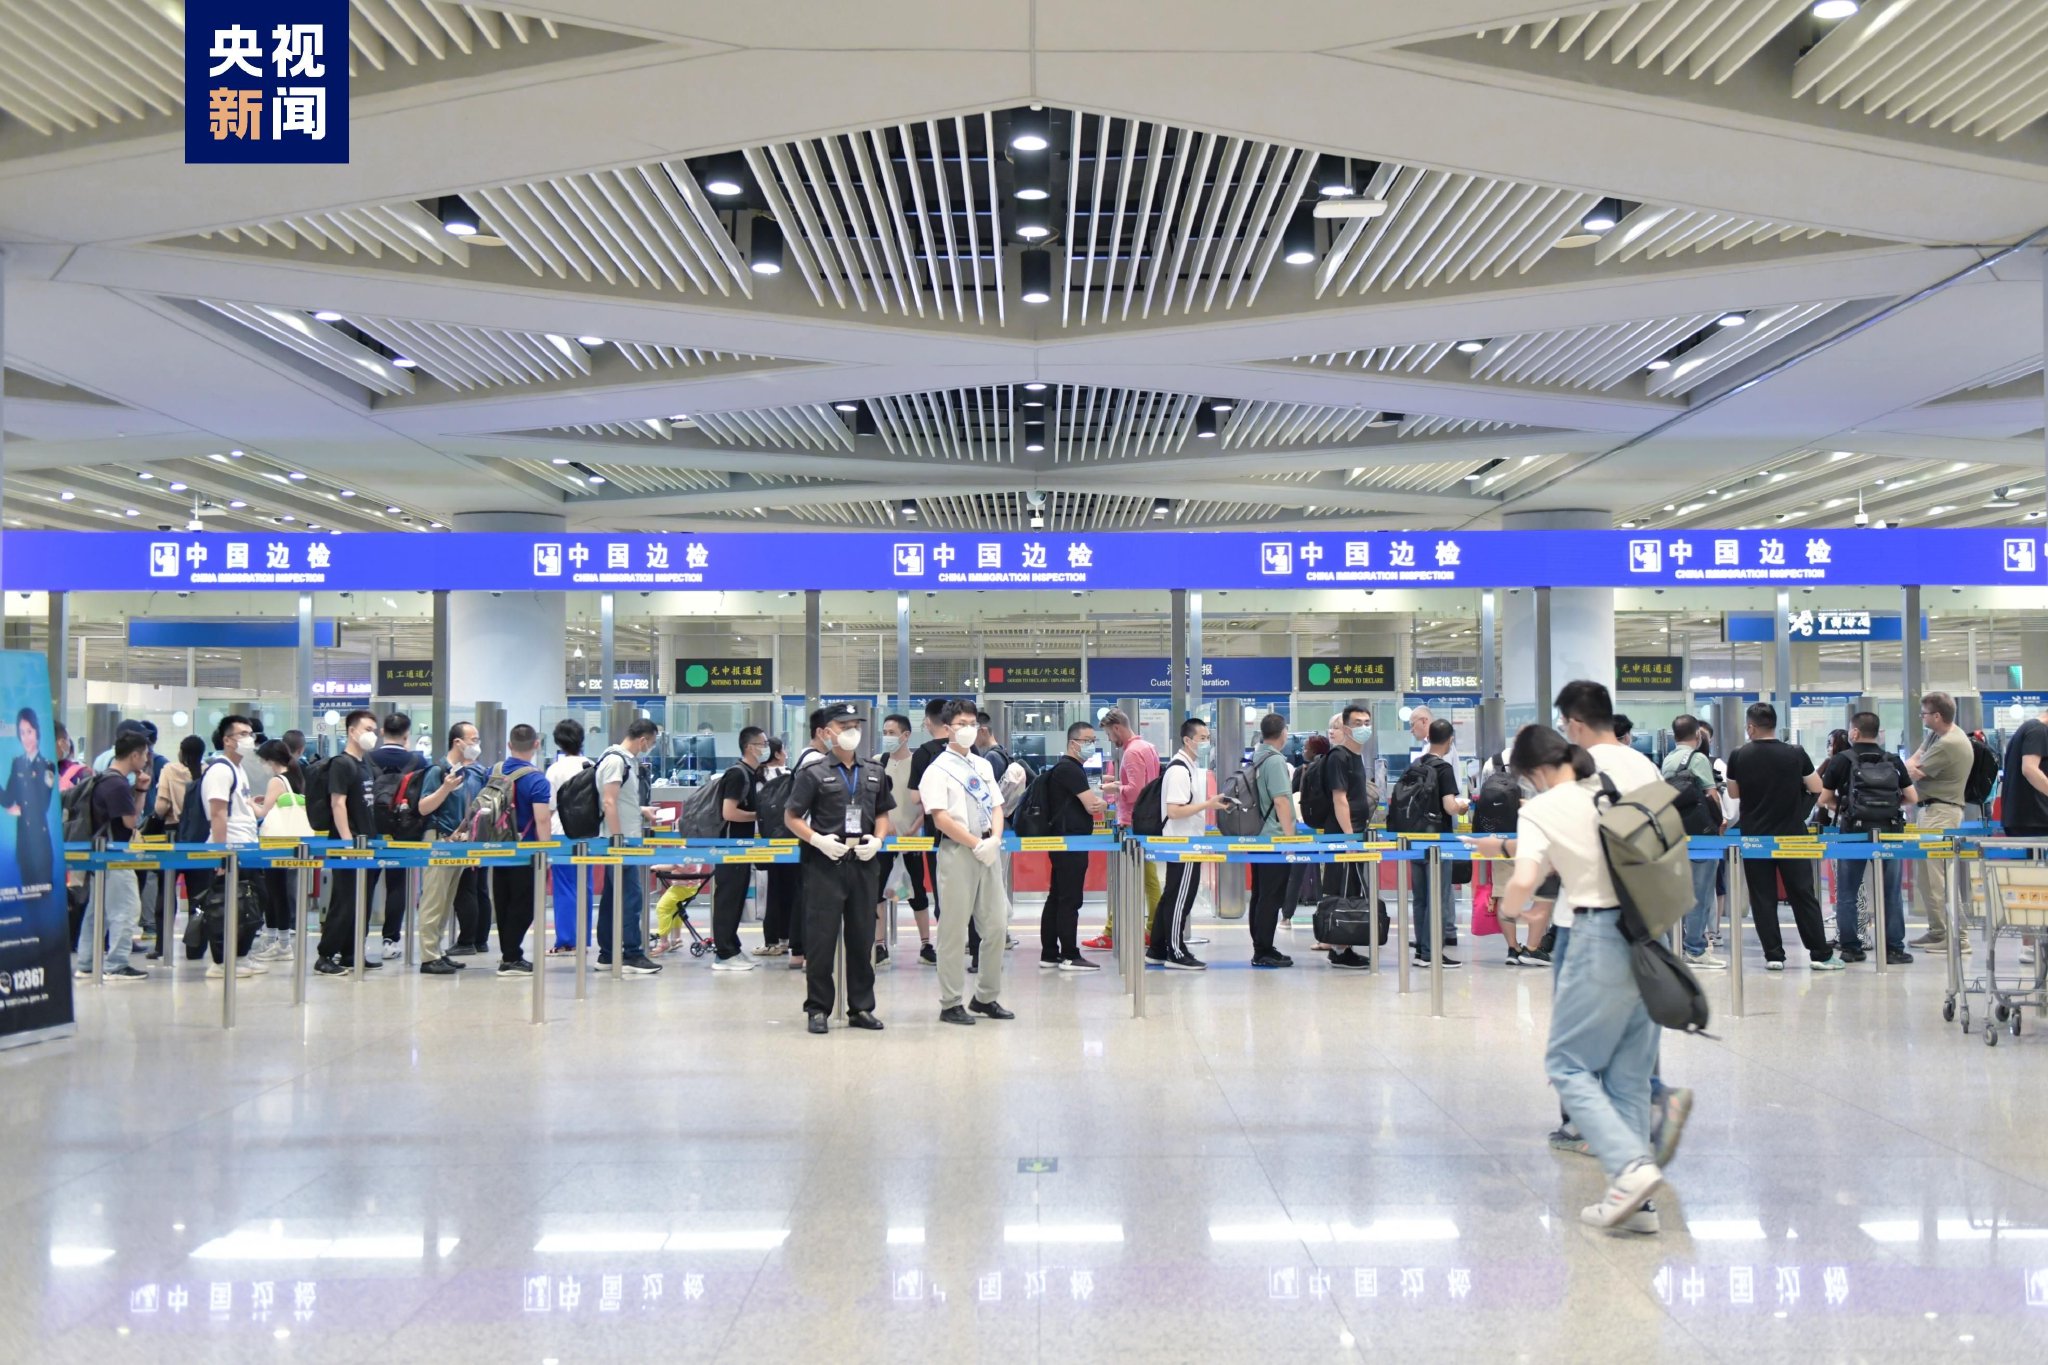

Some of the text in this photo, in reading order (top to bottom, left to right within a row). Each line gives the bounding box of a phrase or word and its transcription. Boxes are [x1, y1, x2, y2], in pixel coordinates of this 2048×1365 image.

[186, 541, 331, 569] 中国边检
[568, 542, 708, 569] 中国边检
[933, 542, 1093, 569] 中国边检
[1300, 541, 1460, 567] 中国边检
[1669, 538, 1831, 565] 中国边检
[711, 665, 763, 676] 无申报通道
[1333, 664, 1384, 675] 无申报通道
[12, 967, 44, 991] 12367
